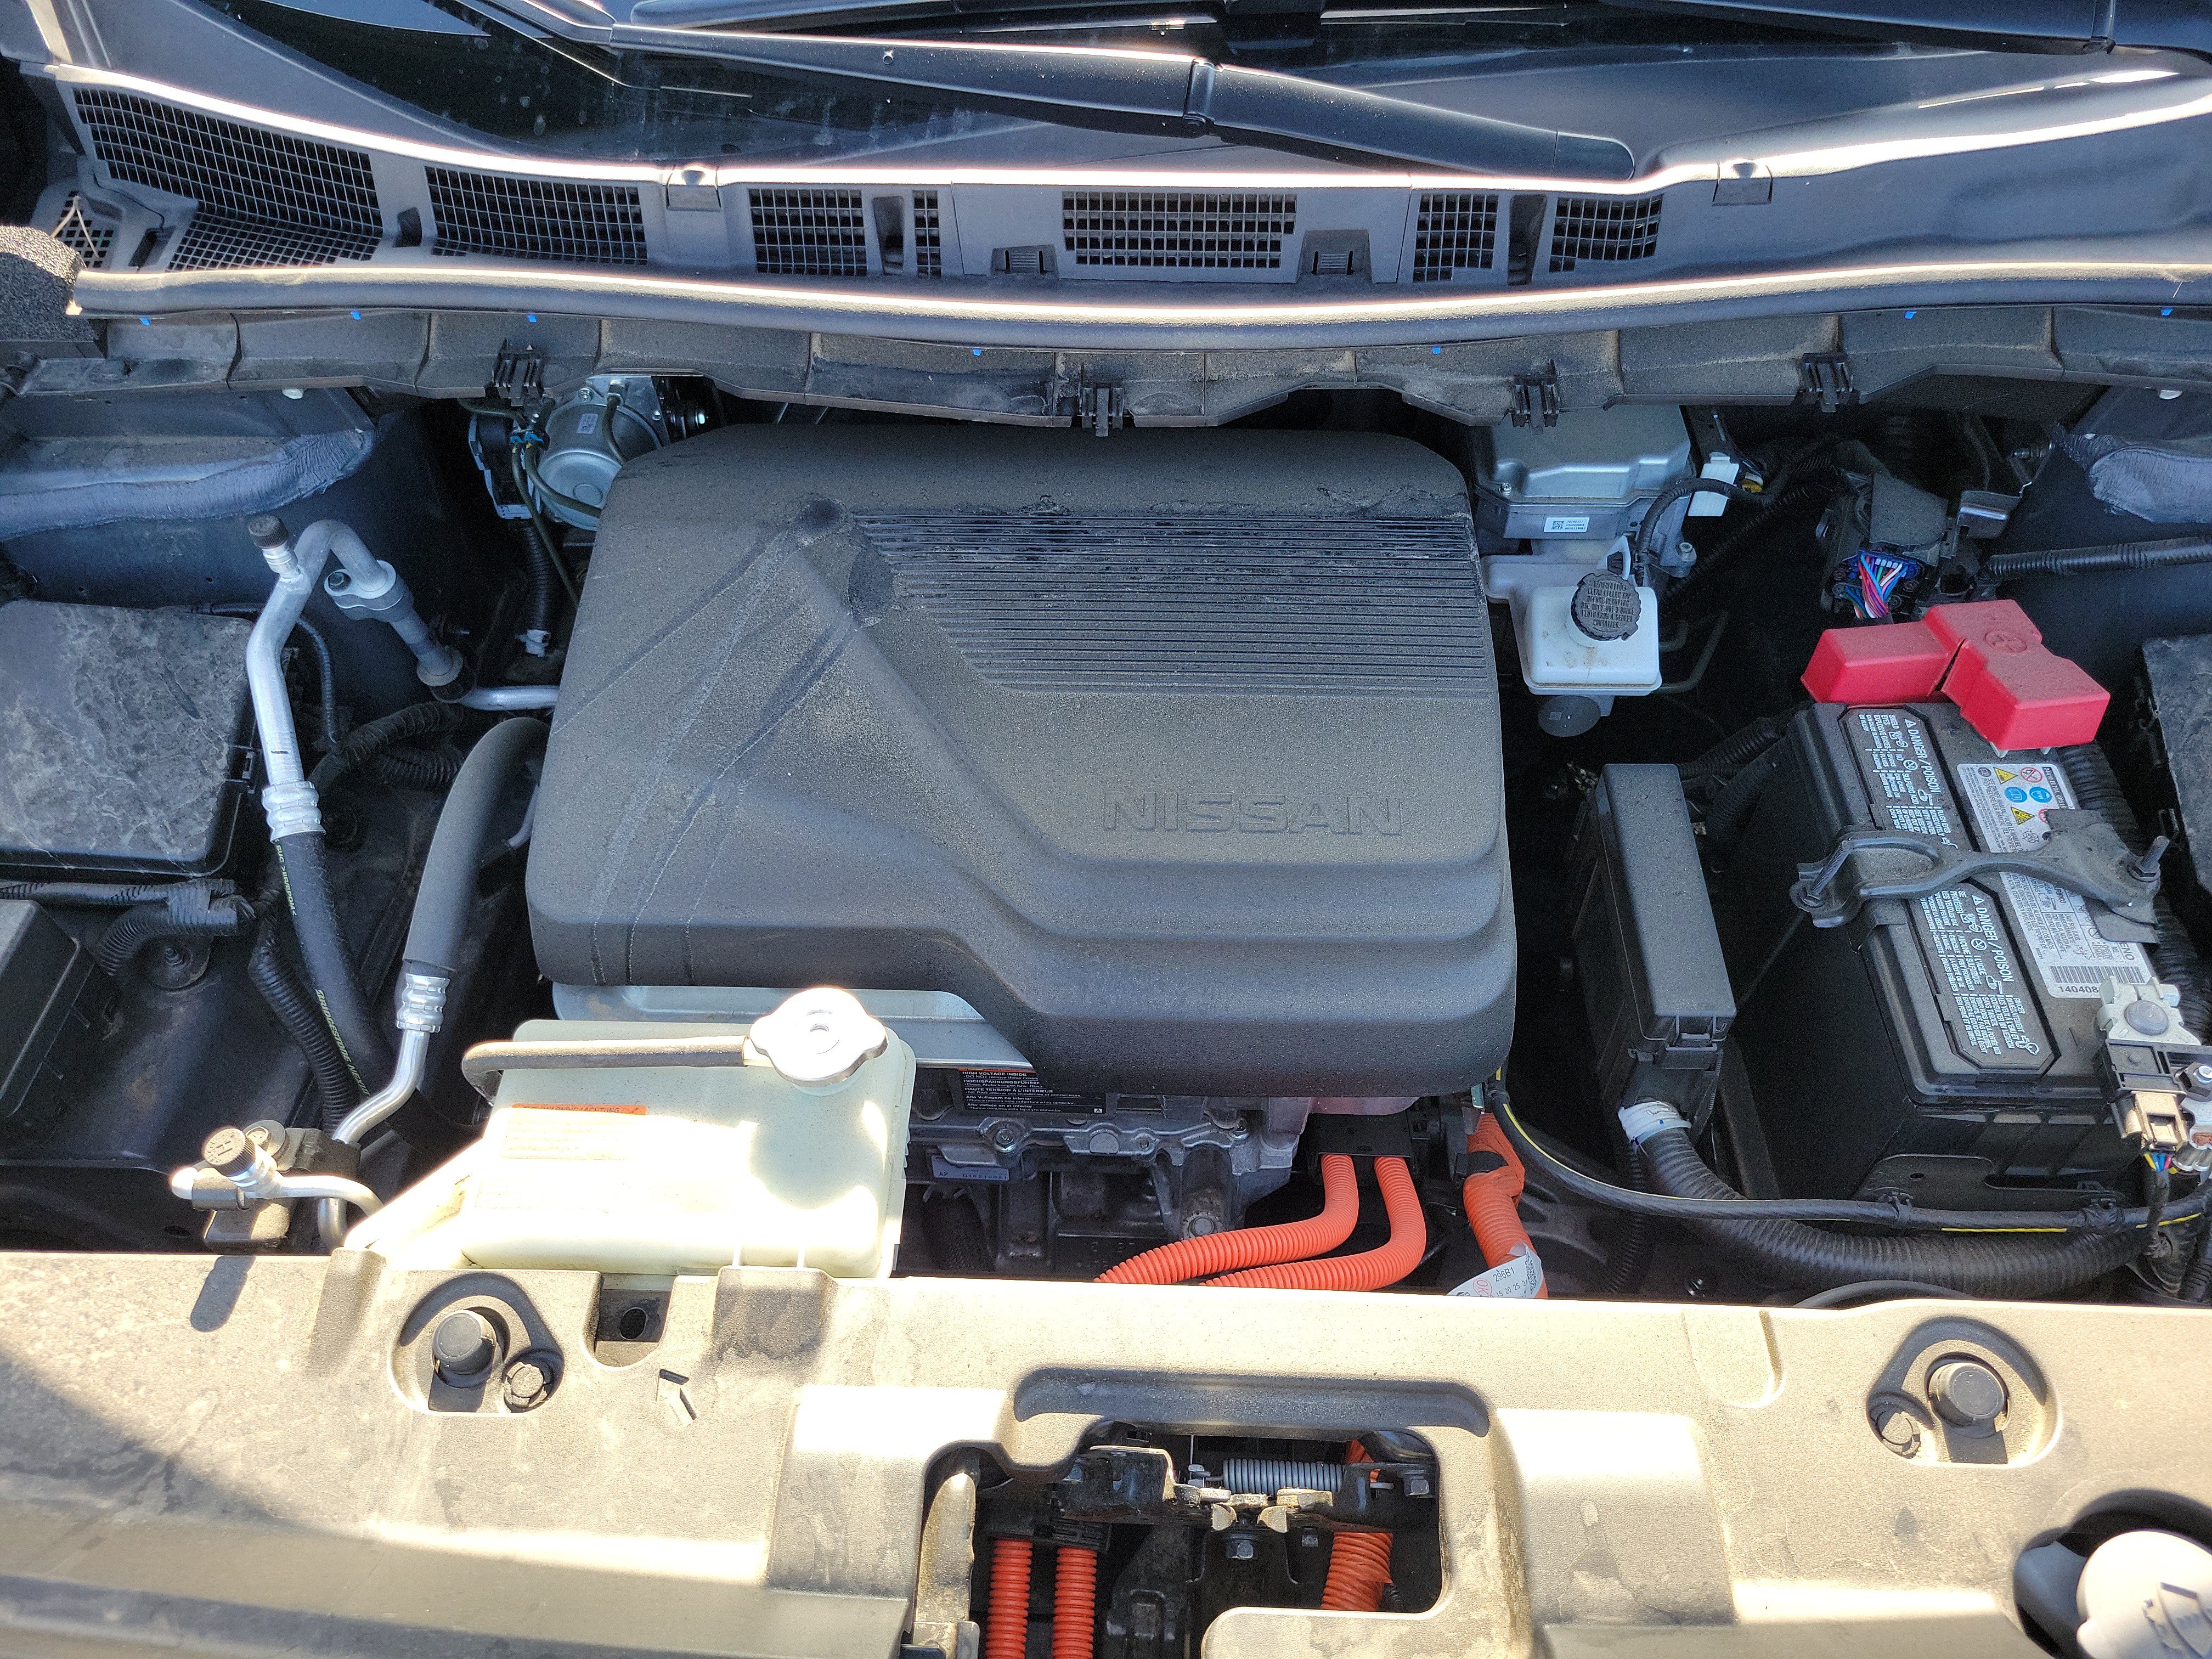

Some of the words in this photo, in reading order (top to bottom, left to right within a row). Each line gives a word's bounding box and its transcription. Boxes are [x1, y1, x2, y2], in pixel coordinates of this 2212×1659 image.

[1588, 588, 1602, 596] CLEAN
[1594, 581, 1626, 591] WARNING
[1587, 595, 1604, 603] BEFORE
[1597, 612, 1609, 620] FROM
[1881, 714, 1890, 725] EYES
[1888, 714, 1899, 729] SHIELD
[1873, 714, 1887, 735] EXPLOSIVE
[1881, 735, 1891, 748] GASES
[1886, 753, 1896, 767] SPARKS
[1901, 772, 1915, 793] SULFURIC
[1909, 793, 1919, 804] ACID
[1102, 791, 1402, 836] NISSAN
[1936, 809, 1946, 822] FLUSH
[1941, 822, 1951, 833] EYES
[1941, 890, 1950, 899] LES
[1944, 900, 1955, 911] YEUX
[1957, 935, 1971, 955] AUCUNE
[1966, 958, 1982, 984] SULFURIQUE
[1982, 997, 1992, 1008] SANS
[1997, 997, 2006, 1005] LES
[1989, 997, 2005, 1021] CONSULTER
[2001, 1006, 2010, 1017] YEUX
[1493, 1267, 1515, 1282] 296B1
